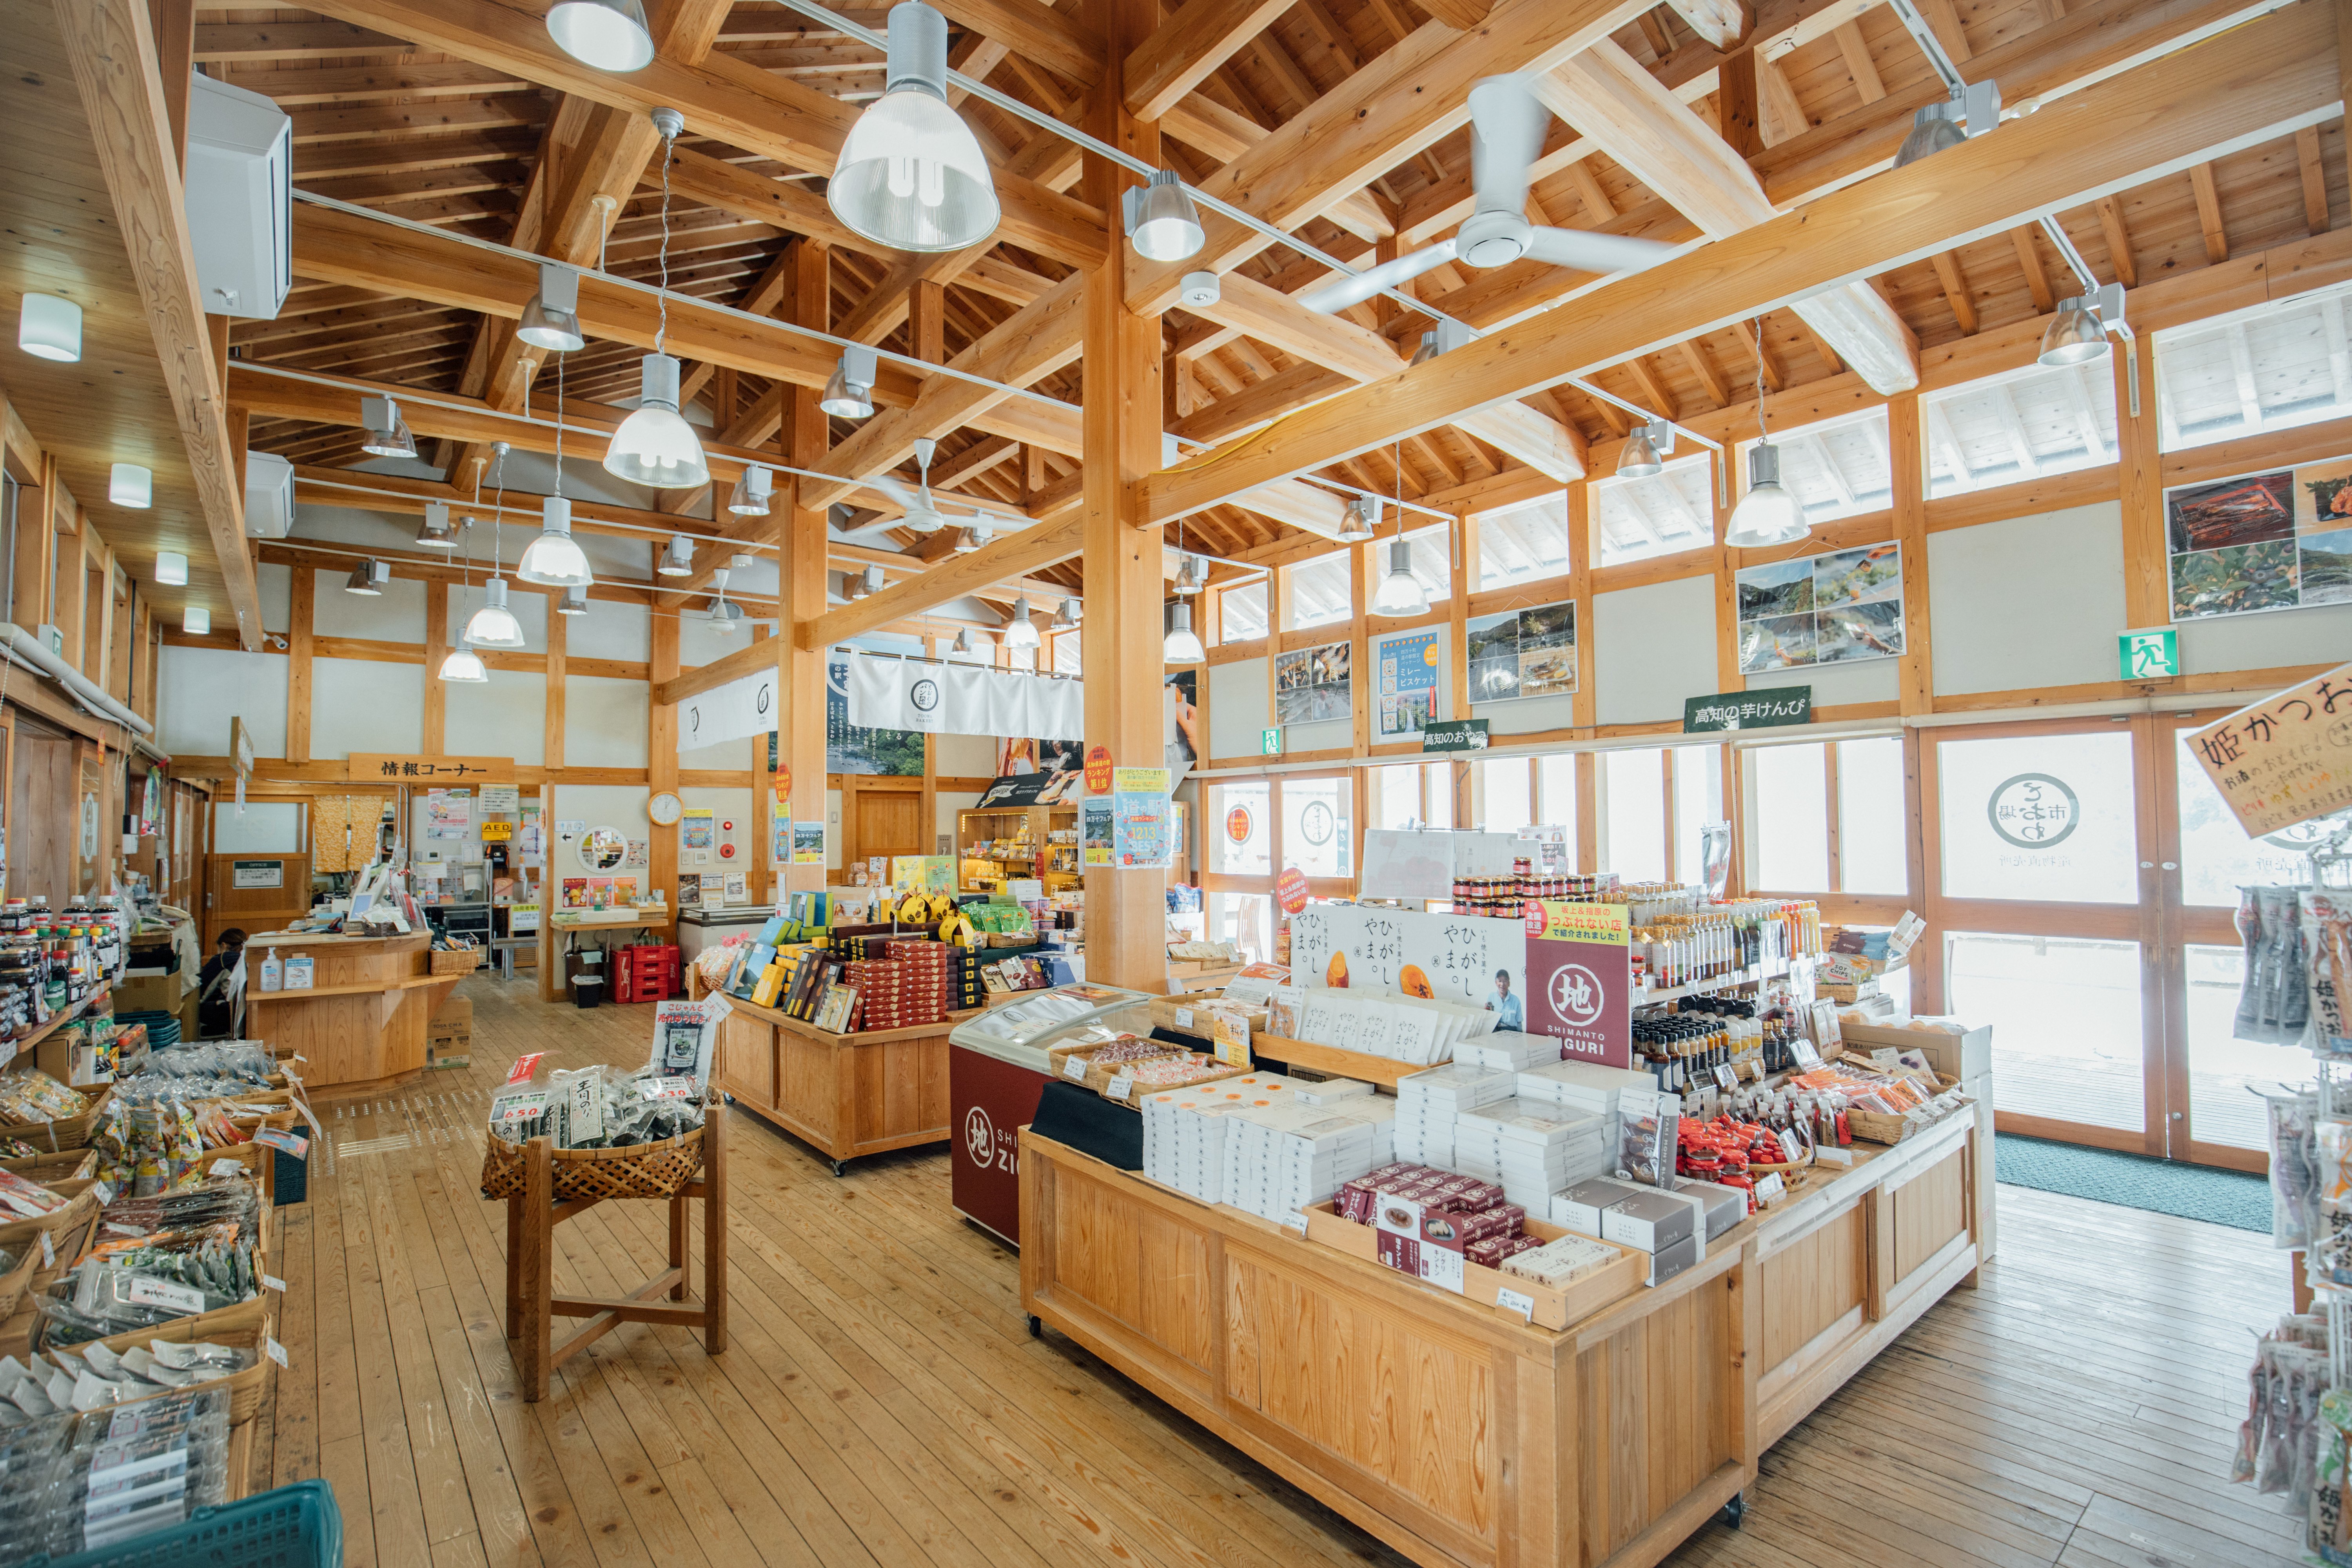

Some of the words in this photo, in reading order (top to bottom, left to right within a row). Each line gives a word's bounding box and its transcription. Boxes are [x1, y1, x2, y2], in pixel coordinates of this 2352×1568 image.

[1401, 675, 1434, 686] ビスケット
[918, 684, 927, 704] パン屋
[1695, 699, 1805, 724] 高知の芋けんぴ
[381, 762, 486, 776] 情報コーナー
[1087, 760, 1111, 768] 高知県道の駅
[1087, 767, 1111, 778] ランキング
[1091, 778, 1107, 788] 第1位
[1131, 827, 1156, 840] 1213
[1131, 840, 1157, 852] BEST
[1279, 872, 1299, 885] 全国テレビ
[1526, 912, 1541, 921] 全国
[1526, 921, 1541, 929] 放送
[1551, 916, 1622, 931] つぶれない店
[1296, 912, 1307, 962] やま。
[1309, 914, 1321, 973] ひがし
[1365, 918, 1377, 972] やま。
[1379, 920, 1394, 984] ひがし
[1444, 924, 1459, 983] やま。
[1461, 927, 1477, 996] ひがし
[1830, 968, 1848, 977] CHIPS
[1556, 973, 1595, 1014] 地
[1311, 1010, 1326, 1040] ひがし
[1341, 1014, 1355, 1046] ひがし
[1368, 1017, 1382, 1051] ひがし
[1548, 1025, 1605, 1041] SHIMANTO
[1403, 1023, 1415, 1060] ひがし
[1548, 1035, 1604, 1055] GURI
[970, 1115, 990, 1157] 地
